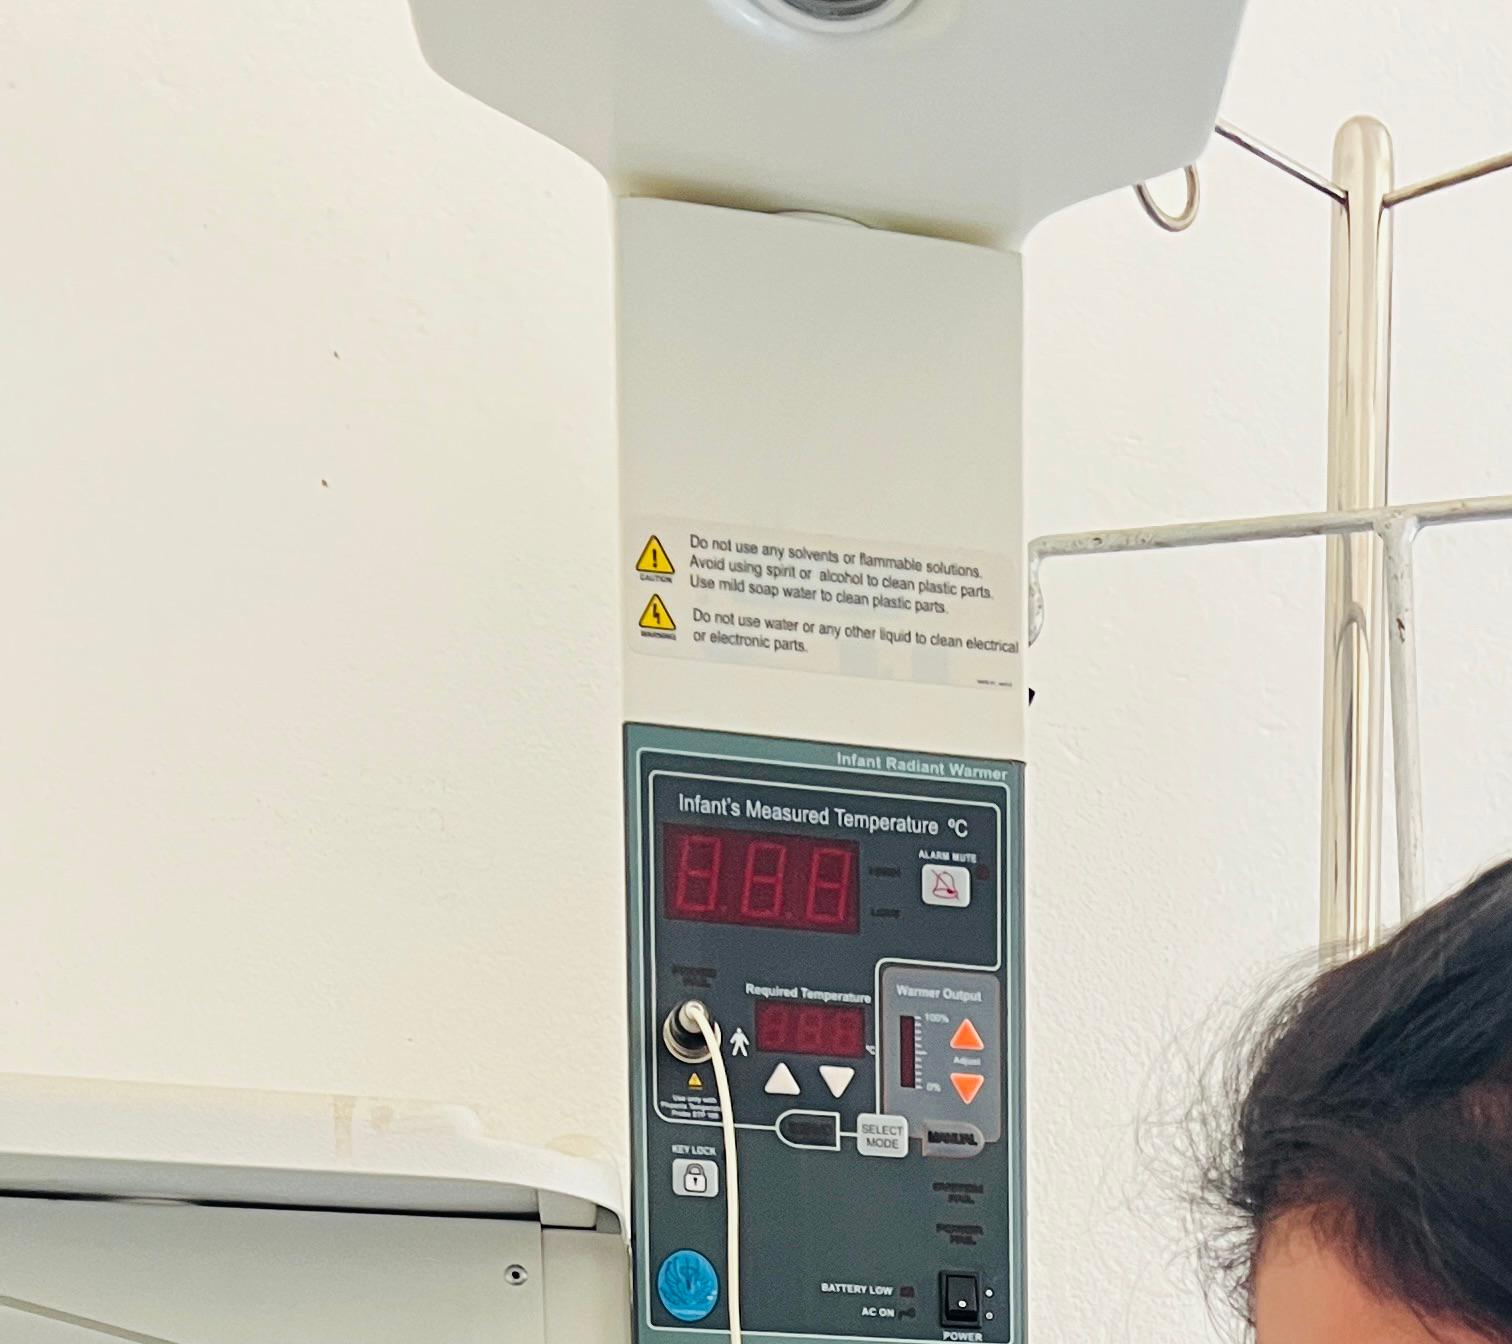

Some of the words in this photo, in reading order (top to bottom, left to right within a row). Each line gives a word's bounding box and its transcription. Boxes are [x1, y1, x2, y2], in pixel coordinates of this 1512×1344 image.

[690, 534, 708, 549] Do
[712, 539, 732, 552] not
[736, 543, 758, 554] use
[762, 546, 784, 559] any
[789, 547, 839, 563] solvents
[843, 554, 855, 564] or
[860, 552, 922, 572] flammable
[926, 562, 982, 578] solutions.
[693, 608, 711, 623] Do
[715, 613, 735, 625] not
[738, 616, 761, 628] use
[764, 619, 798, 631] water
[803, 622, 815, 633] or
[819, 624, 841, 638] any
[845, 626, 876, 639] other
[880, 627, 911, 643] liquid
[915, 632, 927, 645] to
[930, 633, 962, 647] clean
[966, 637, 1019, 653] electrical
[837, 752, 881, 770] Infant
[886, 758, 945, 777] Radiant
[950, 765, 1009, 781] Warmer
[679, 793, 740, 816] Infant's
[746, 800, 829, 825] Measured
[834, 808, 938, 835] Temperature
[919, 849, 949, 860] ALARM
[952, 853, 976, 863] MUTE
[746, 983, 798, 998] Required
[801, 987, 871, 1003] Temperature
[896, 984, 940, 998] Warmer
[943, 988, 982, 1002] Output
[862, 1124, 904, 1136] SELECT
[672, 1145, 690, 1153] KEY
[691, 1146, 716, 1156] LOCK
[866, 1138, 899, 1149] MODE
[821, 1283, 867, 1293] BATTERY
[869, 1286, 893, 1295] LOW
[862, 1307, 876, 1316] AC
[879, 1308, 894, 1317] ON
[941, 1332, 982, 1343] POWER
